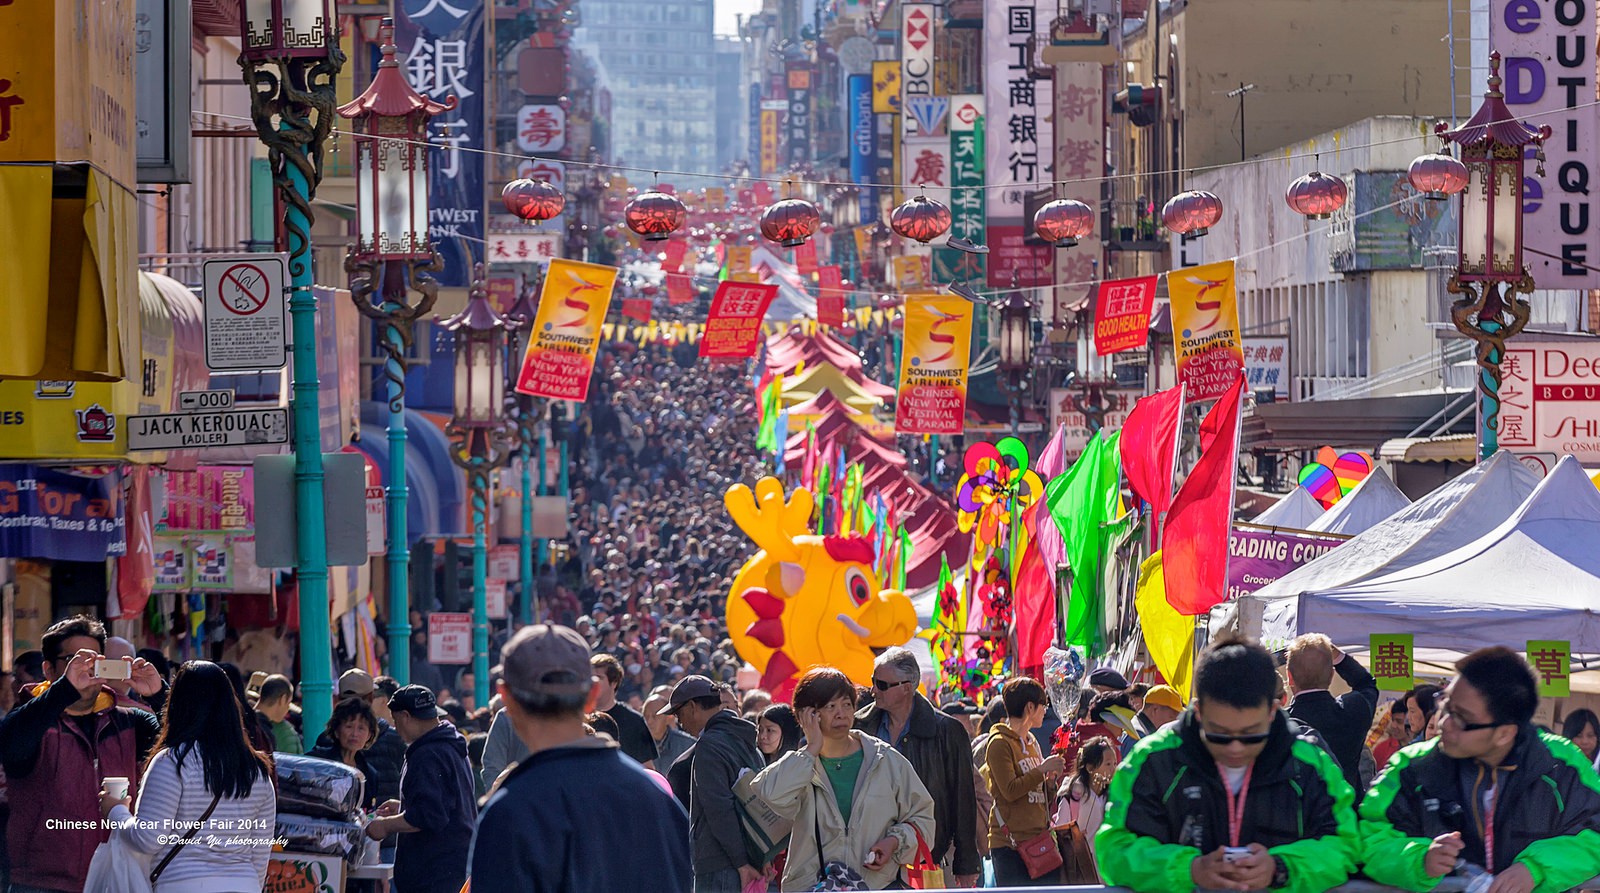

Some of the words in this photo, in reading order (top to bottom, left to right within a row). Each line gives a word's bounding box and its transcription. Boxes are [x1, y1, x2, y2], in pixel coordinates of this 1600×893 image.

[857, 91, 872, 156] citibank
[1097, 318, 1119, 338] GOOD
[1119, 314, 1148, 333] HEALTH
[538, 332, 594, 345] SOUTHWEST
[1181, 330, 1234, 348] SOUTHWEST
[535, 342, 592, 354] AIRLINES
[1182, 339, 1235, 357] AIRLINES
[1189, 350, 1230, 366] CHINESE
[907, 368, 964, 377] SOUTHWEST
[1183, 365, 1206, 377] NEW
[1210, 360, 1239, 371] YEAR
[906, 378, 961, 386] AIRLINES
[1189, 371, 1235, 387] FESTIVAL
[200, 393, 229, 406] 000
[912, 387, 955, 398] CHINESE
[1498, 355, 1529, 441] 美之屋
[1543, 387, 1595, 399] BOU
[903, 397, 929, 407] NEW
[934, 399, 961, 408] YEAR
[908, 408, 954, 418] FESTIVAL
[139, 417, 183, 435] JACK
[192, 413, 271, 432] KEROUAC
[917, 419, 957, 429] PARADE
[17, 479, 37, 490] LTE
[50, 517, 84, 531] Taxes
[1374, 642, 1410, 679] 蟲
[1531, 649, 1566, 685] 草
